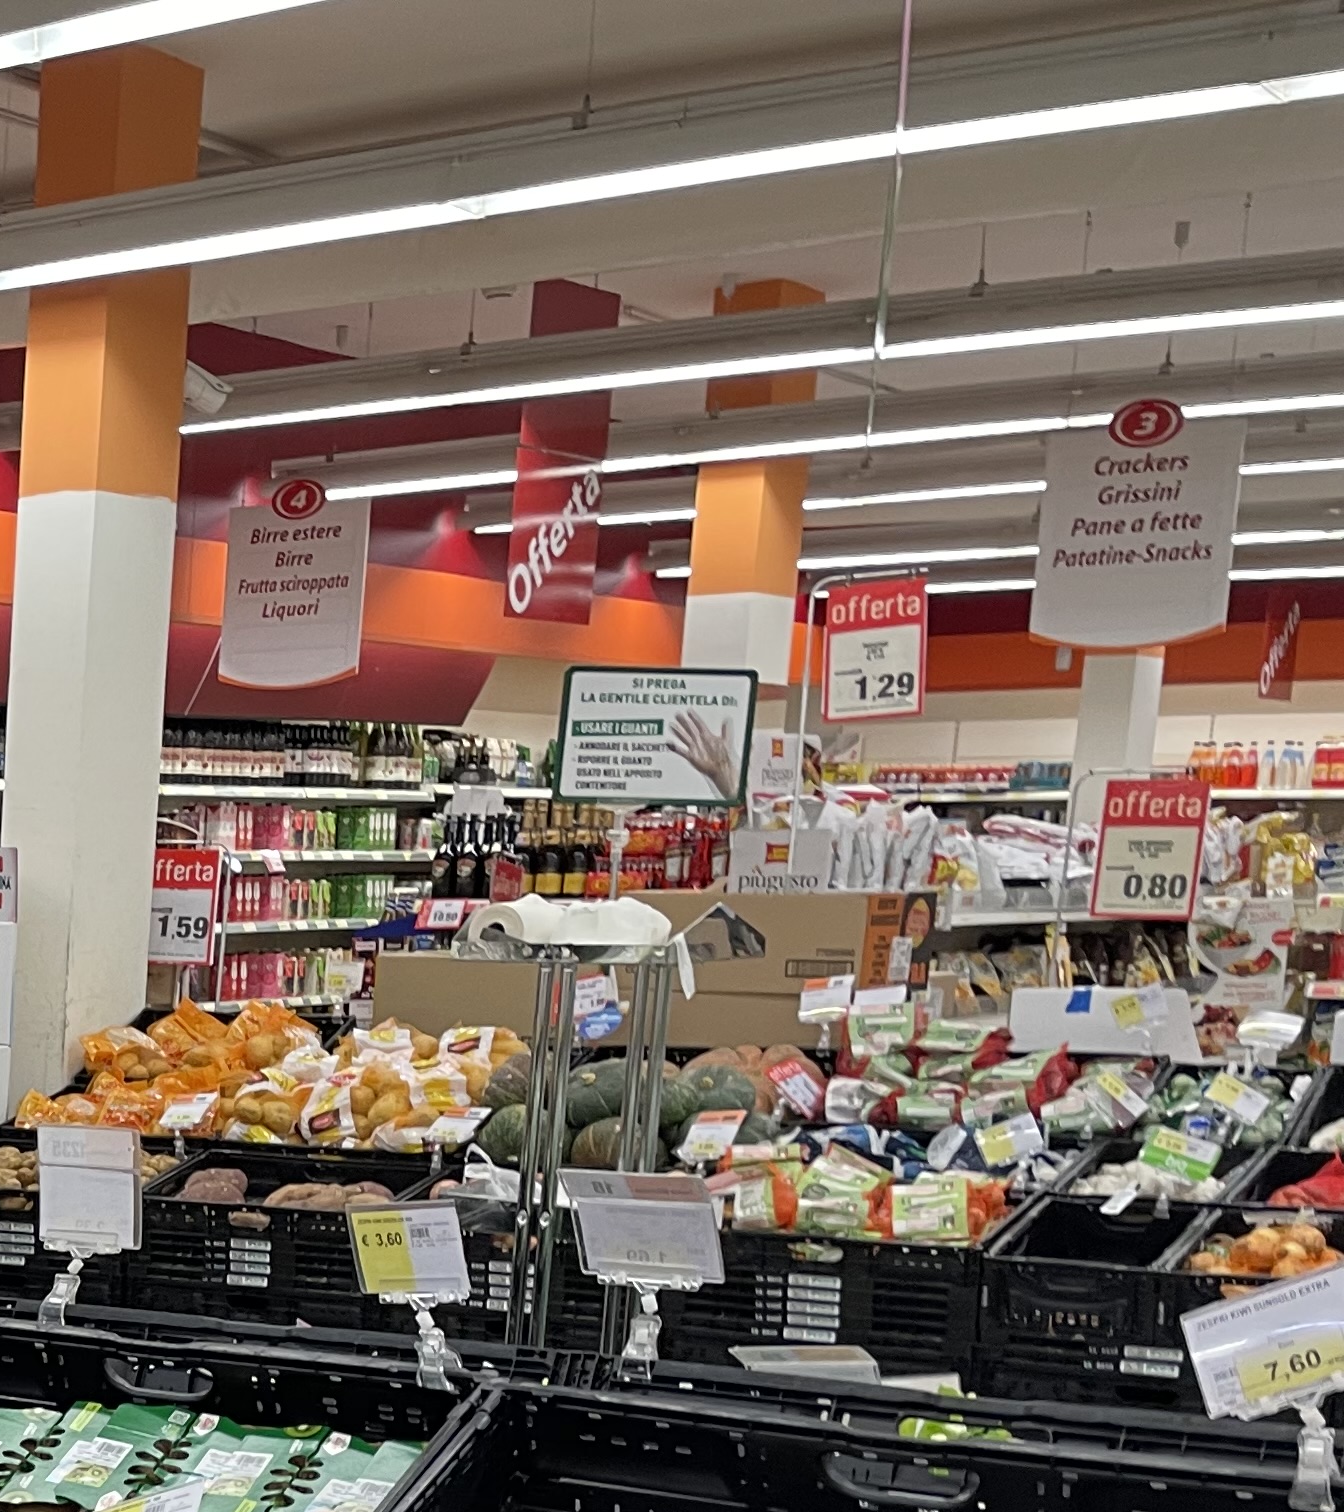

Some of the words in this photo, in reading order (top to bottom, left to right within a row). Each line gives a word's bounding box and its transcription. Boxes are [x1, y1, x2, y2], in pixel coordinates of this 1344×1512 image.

[1133, 412, 1158, 435] 3
[1094, 452, 1190, 476] Crackers
[290, 490, 307, 509] 4
[1098, 480, 1182, 505] Grissini
[250, 527, 289, 544] Birre
[293, 525, 341, 541] estere
[1071, 517, 1126, 537] Pane
[1131, 518, 1145, 533] a
[1150, 511, 1203, 532] fette
[509, 470, 600, 613] Offerta
[275, 550, 313, 567] Birre
[1052, 539, 1214, 568] Patatine-Snacks
[238, 579, 277, 595] Frutta
[279, 574, 350, 594] sciroppata
[262, 598, 320, 621] Liquori
[832, 592, 921, 624] offerta
[632, 678, 643, 689] SI
[647, 678, 686, 689] PREGA
[855, 671, 915, 701] 1,29
[581, 692, 595, 703] LA
[599, 693, 649, 704] GENTILE
[653, 694, 718, 706] CLIENTELA
[1108, 790, 1202, 820] offerta
[156, 861, 214, 882] fferta
[1123, 873, 1188, 901] 0,80
[159, 916, 209, 939] 1,59
[362, 1234, 370, 1247] €
[376, 1232, 403, 1248] 3,60
[1263, 1348, 1322, 1382] 7,60
